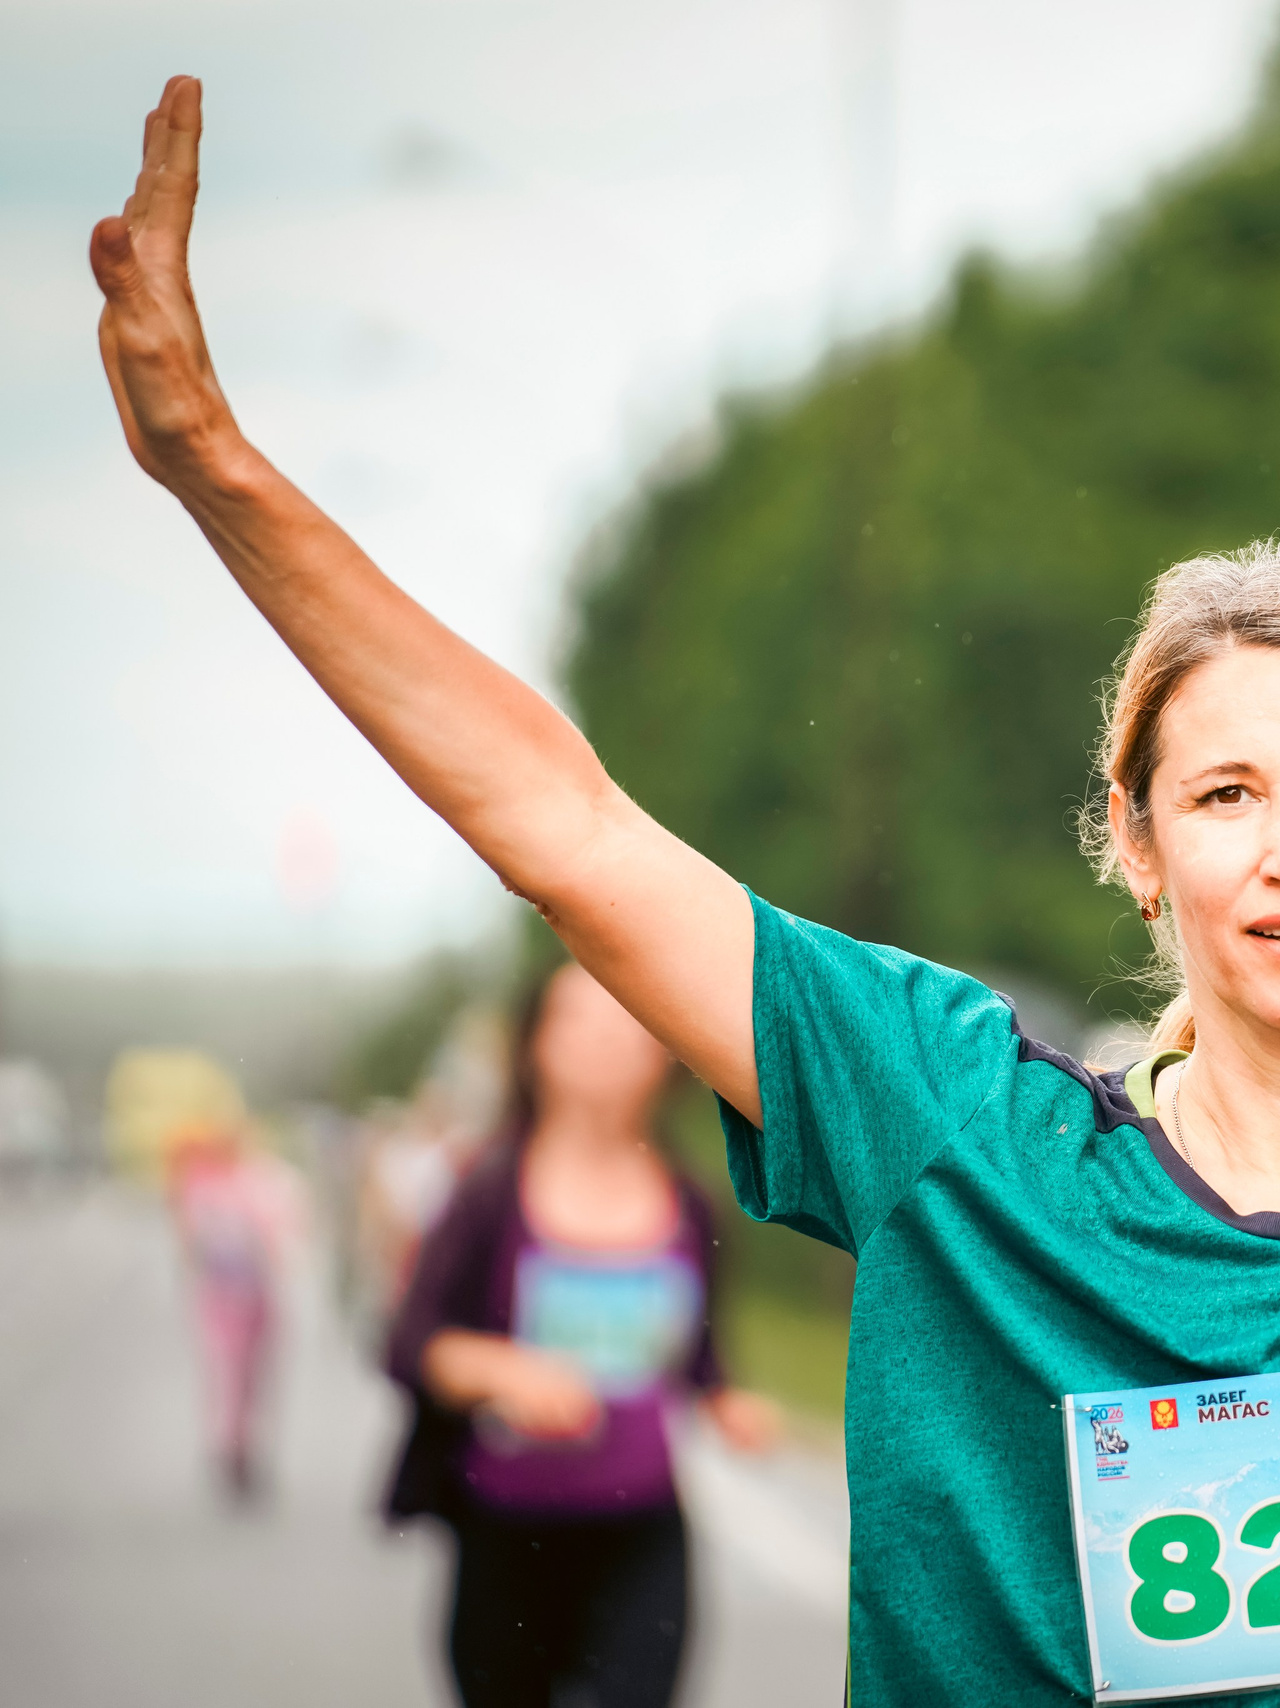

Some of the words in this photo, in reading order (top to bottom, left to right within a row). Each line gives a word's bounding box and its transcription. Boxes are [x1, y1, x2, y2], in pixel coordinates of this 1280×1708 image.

[1196, 1389, 1247, 1407] ЗАБЕГ
[1092, 1407, 1123, 1420] 2026
[1197, 1401, 1270, 1424] МАГАС
